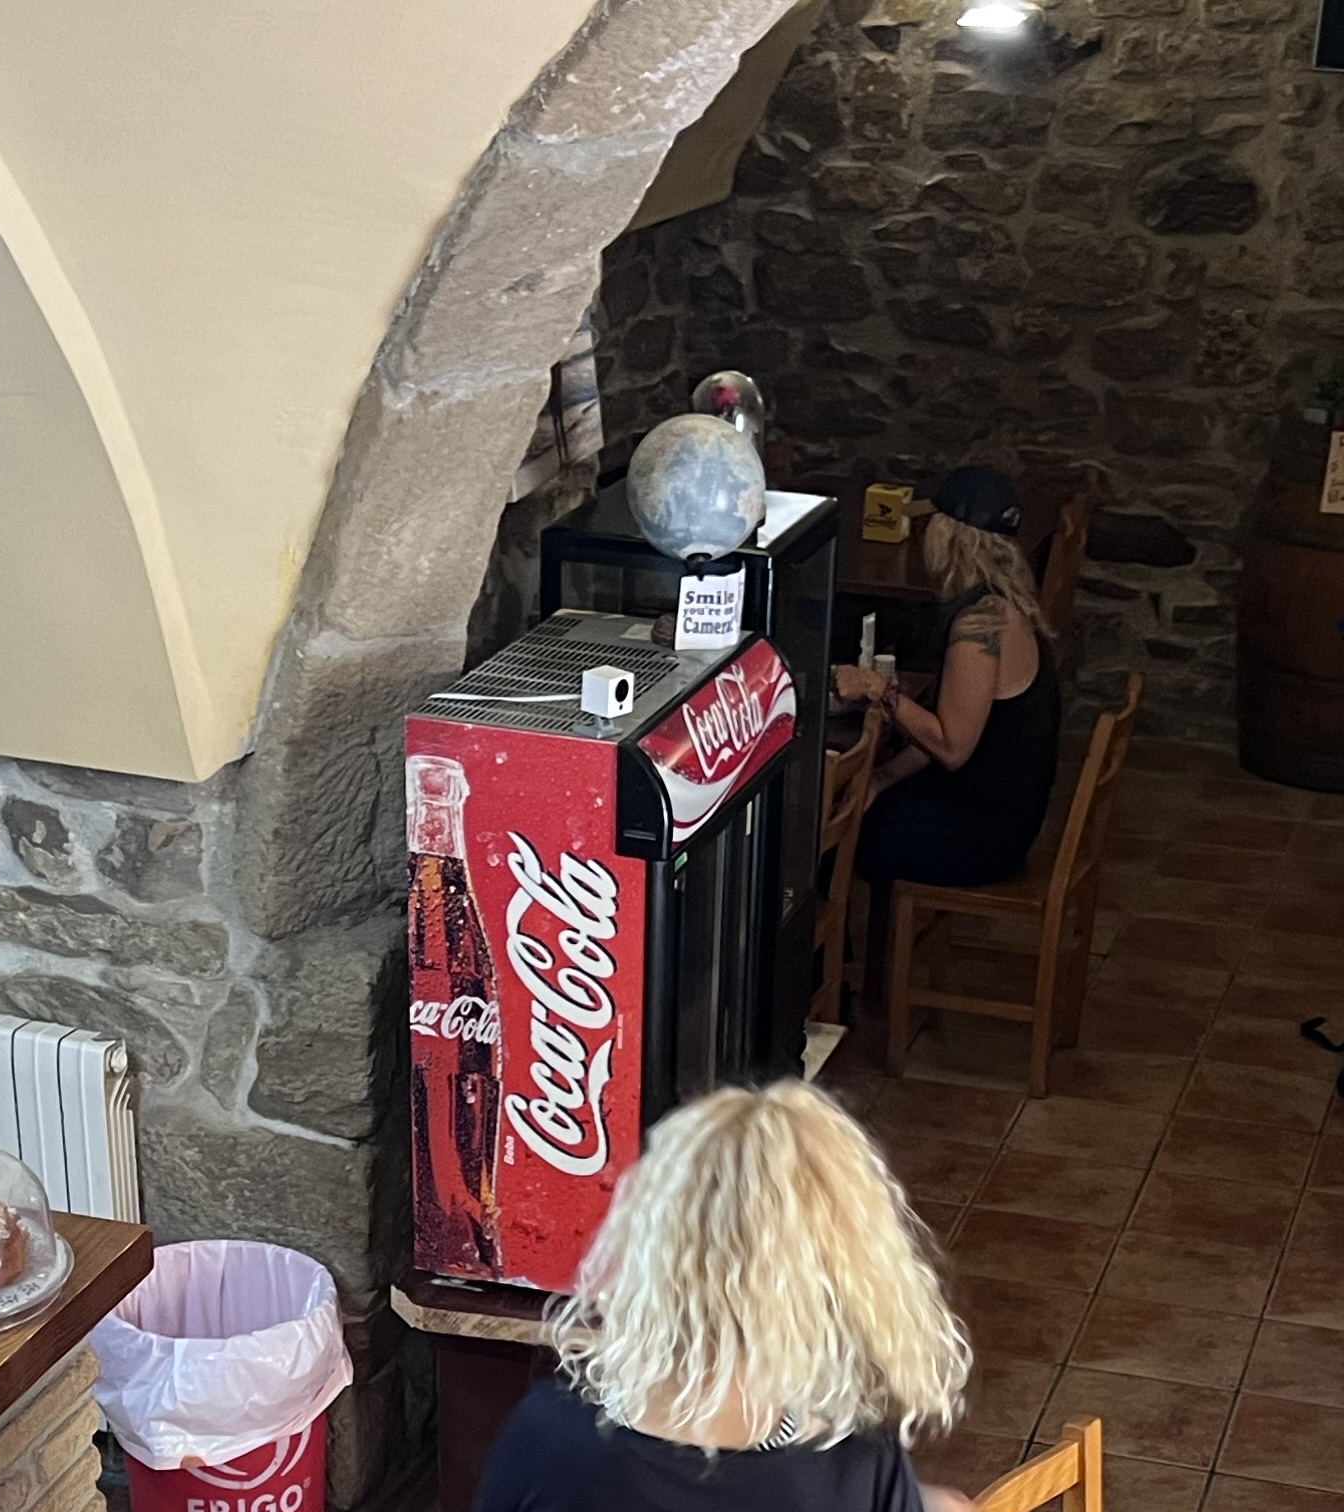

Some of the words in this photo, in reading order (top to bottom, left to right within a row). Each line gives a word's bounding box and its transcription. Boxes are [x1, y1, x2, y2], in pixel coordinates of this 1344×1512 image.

[683, 591, 734, 605] Smile
[682, 606, 721, 617] you're
[506, 831, 619, 1177] Coca-Cola
